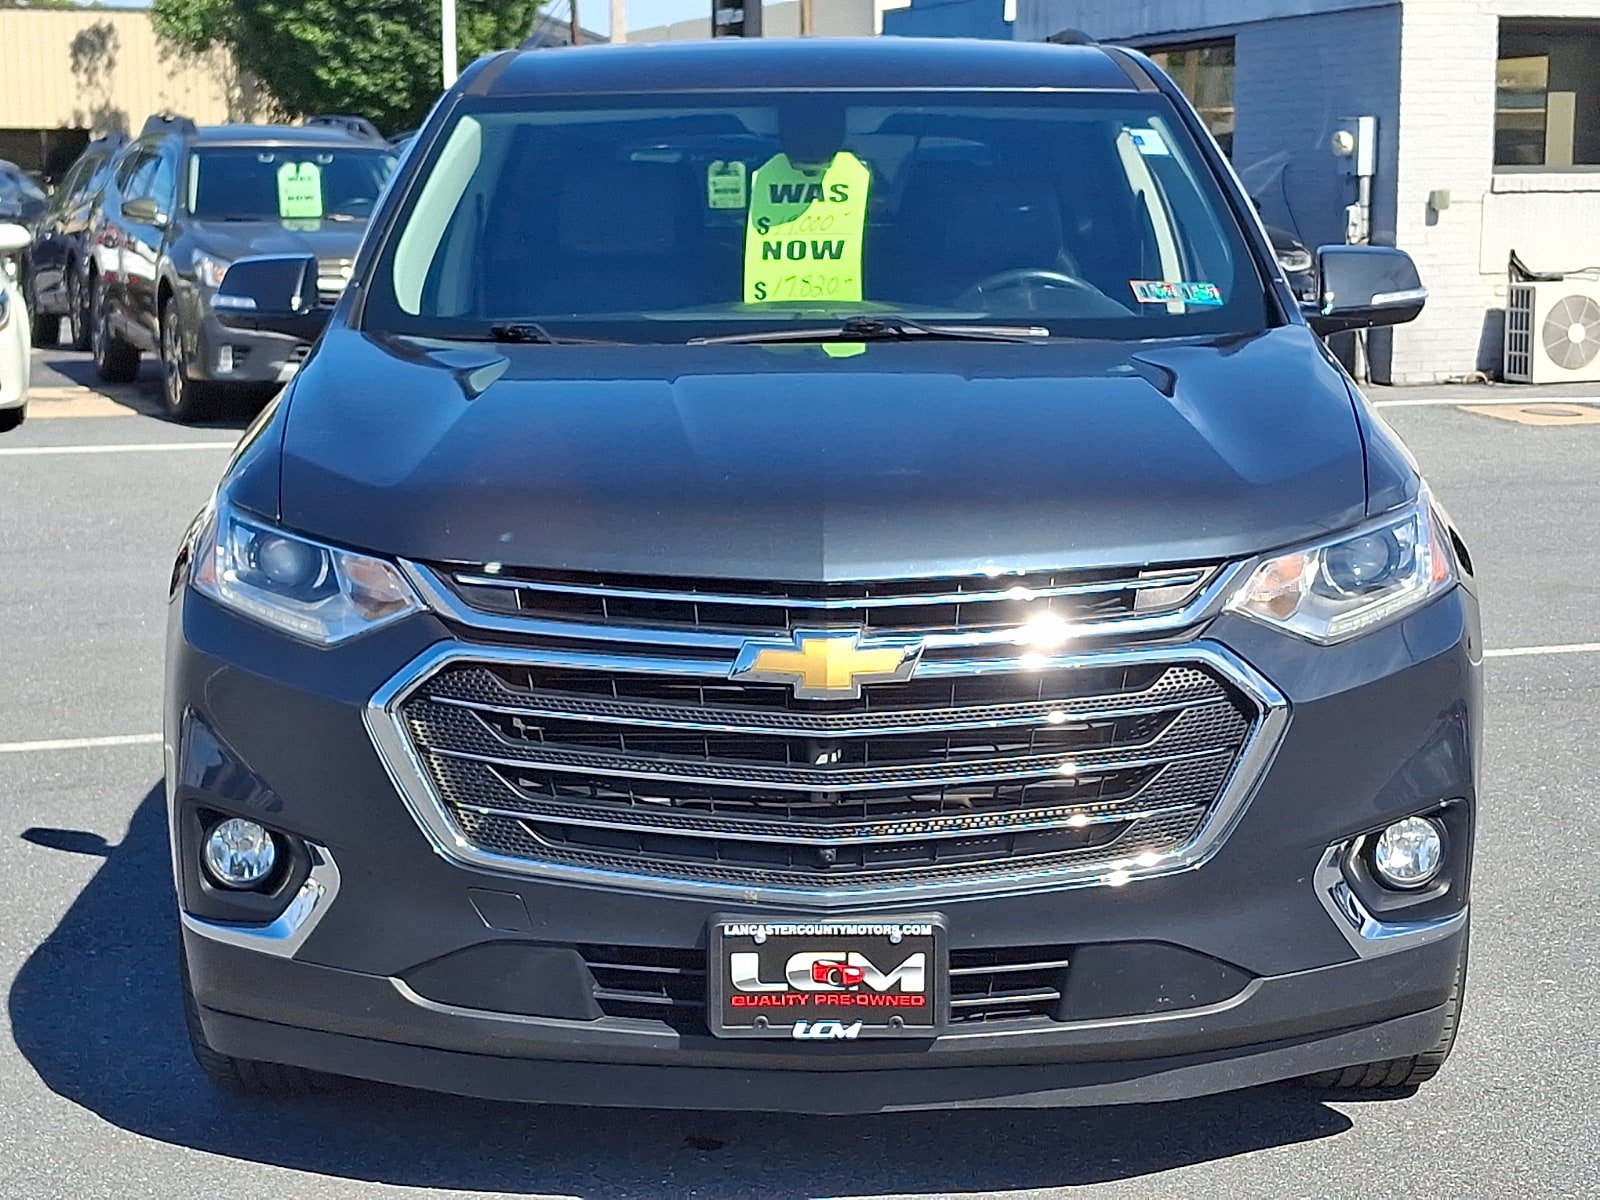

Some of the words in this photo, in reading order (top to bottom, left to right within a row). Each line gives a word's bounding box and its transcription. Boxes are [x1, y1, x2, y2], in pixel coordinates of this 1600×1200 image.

[769, 183, 849, 204] WAS
[762, 240, 845, 260] NOW
[723, 924, 933, 936] LANCASTERCOUNTYMOTORS.COM
[730, 951, 926, 993] LCM
[731, 993, 810, 1007] QUALITY
[814, 993, 926, 1007] PRE-OWNED
[791, 1019, 864, 1040] LCM
